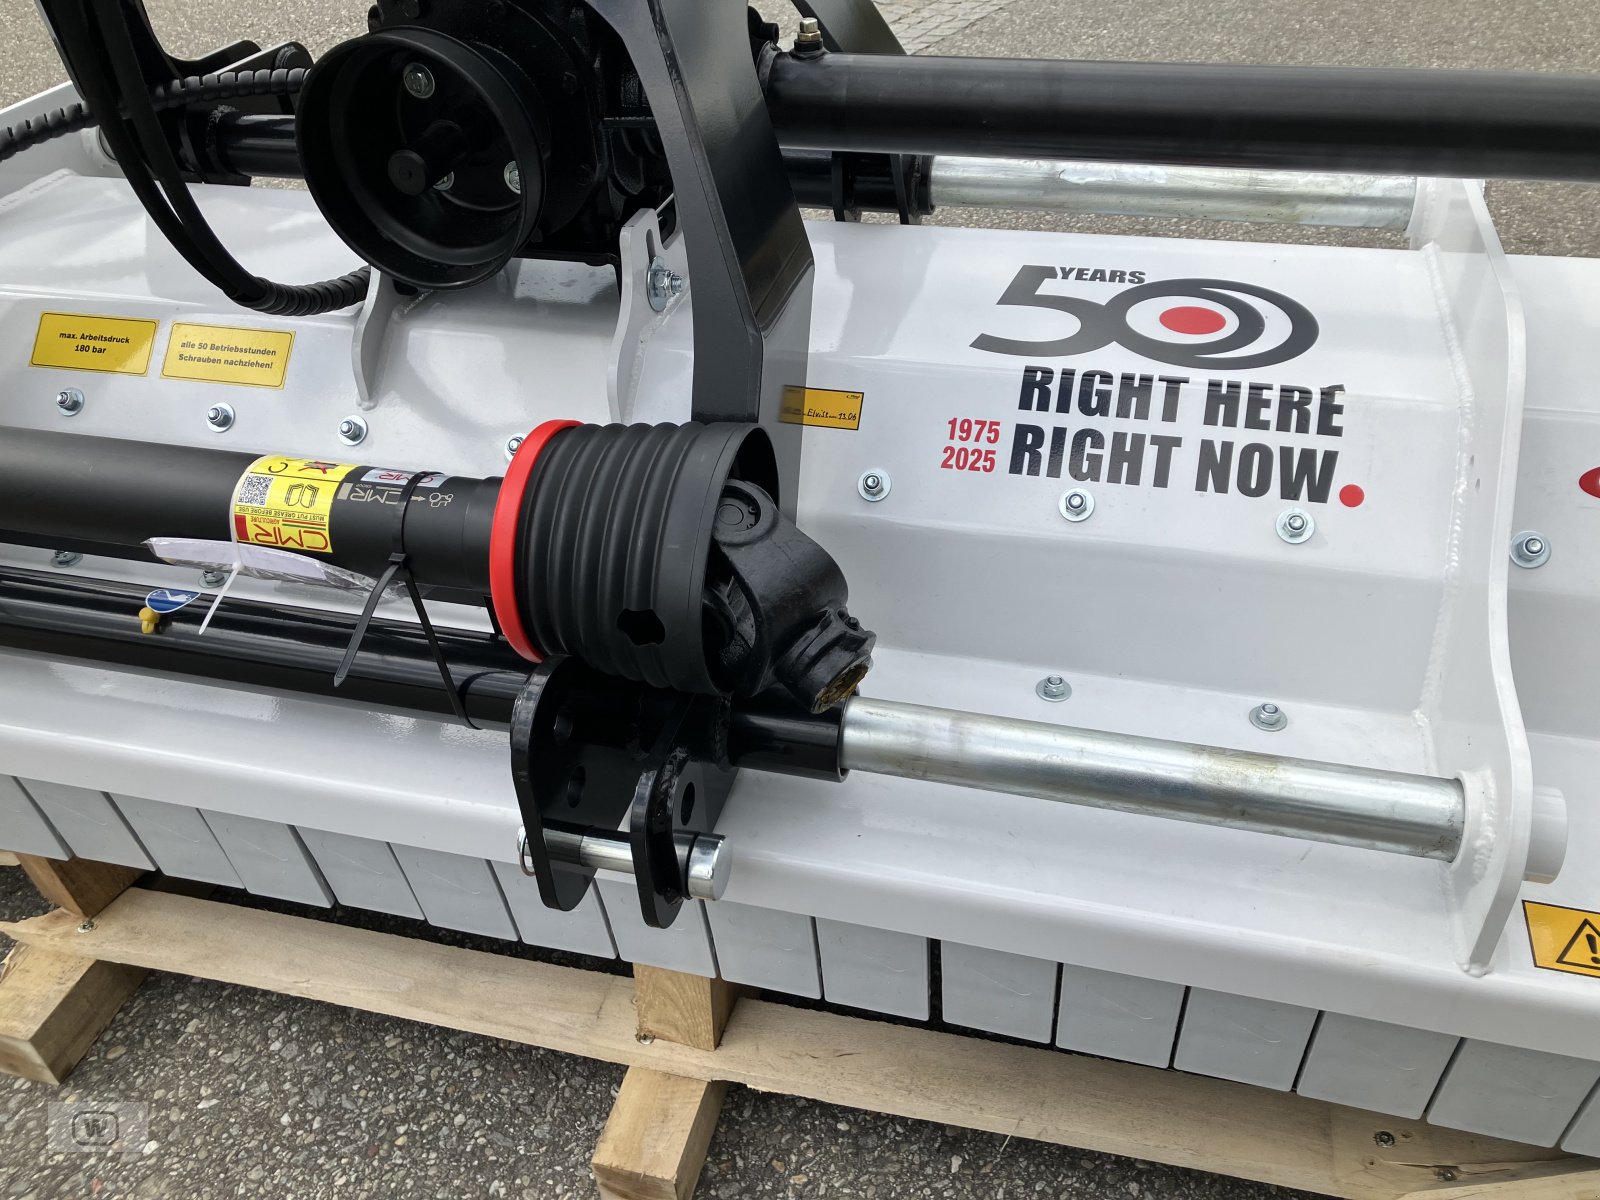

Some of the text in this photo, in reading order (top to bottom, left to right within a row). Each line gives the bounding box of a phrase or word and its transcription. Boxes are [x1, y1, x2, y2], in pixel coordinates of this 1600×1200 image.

[1057, 266, 1146, 285] YEARS
[969, 264, 1320, 370] 50
[59, 331, 130, 344] max. Arbeitsdruck
[75, 344, 107, 354] 180 bar
[180, 341, 277, 356] alle 50 Betriebsstunden
[178, 353, 273, 369] Schrauben nachziehen!
[1017, 365, 1346, 437] RIGHT HERE
[947, 417, 1001, 444] 1975
[940, 445, 997, 473] 2025
[1008, 423, 1184, 489] RIGHT
[250, 508, 272, 517] BEFORE
[250, 516, 280, 525] AGRICULTURE
[274, 510, 296, 519] GREASE
[309, 514, 325, 522] MUST
[252, 523, 329, 551] CMR
